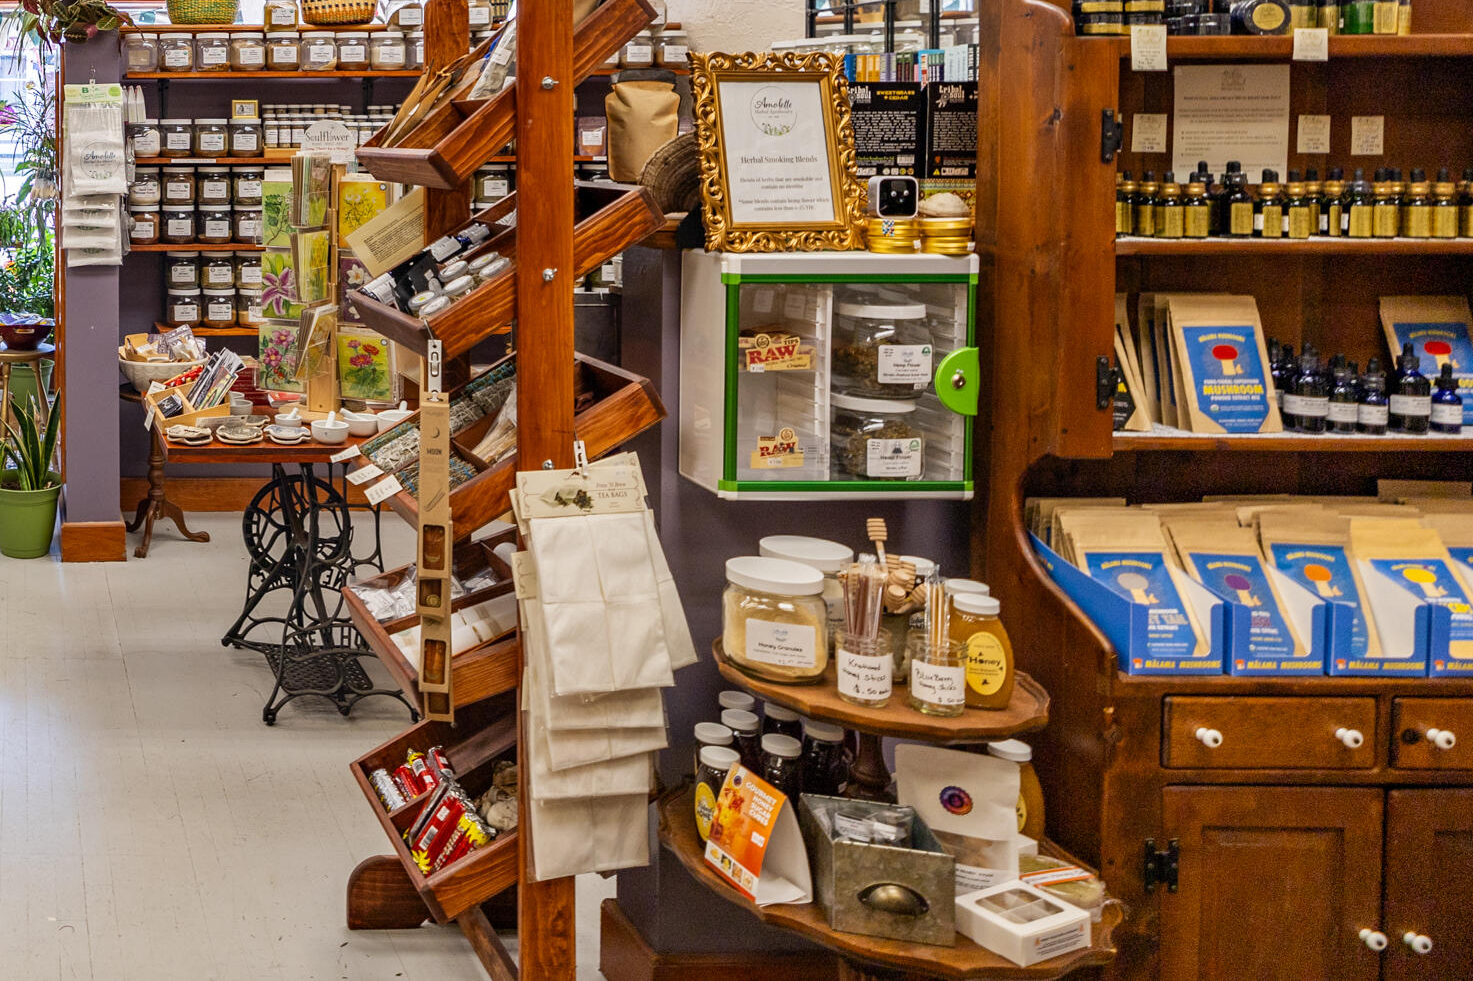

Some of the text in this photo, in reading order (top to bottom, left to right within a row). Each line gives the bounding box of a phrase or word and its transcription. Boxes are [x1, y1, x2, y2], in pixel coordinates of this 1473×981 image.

[740, 156, 764, 164] Herbal
[764, 156, 794, 164] Smoking
[748, 344, 797, 364] RAW
[1203, 384, 1264, 395] MUSHROOM
[760, 442, 796, 457] RAW
[758, 642, 803, 652] Honey Granules
[968, 656, 1001, 666] Honey
[746, 782, 777, 805] GOURMET
[751, 802, 772, 818] SUGAR
[752, 795, 774, 812] HONEY
[749, 809, 769, 826] CUBES
